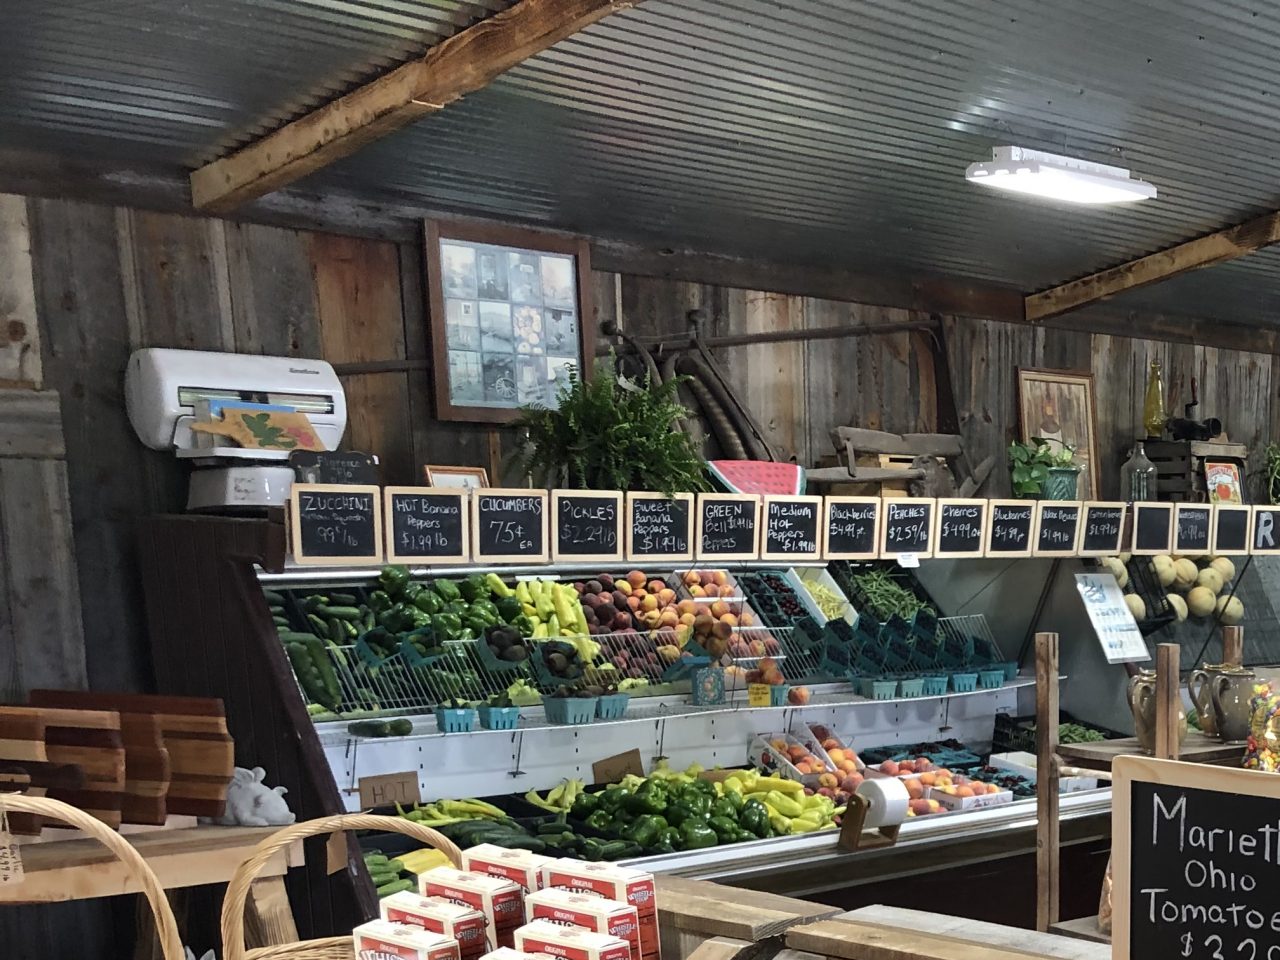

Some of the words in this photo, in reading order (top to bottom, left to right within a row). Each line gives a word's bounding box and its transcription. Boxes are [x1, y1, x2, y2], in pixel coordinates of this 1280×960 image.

[302, 495, 371, 511] ZUCCHINI
[396, 499, 418, 513] HOT
[422, 500, 459, 514] Banana
[480, 498, 542, 515] CUCUMBERS
[562, 500, 614, 520] PICKLES
[770, 504, 811, 518] Medium
[705, 504, 742, 519] GREEN
[889, 504, 925, 520] PEACHES
[407, 515, 441, 530] Peppers
[372, 781, 410, 804] HOT
[1184, 859, 1257, 892] Ohio
